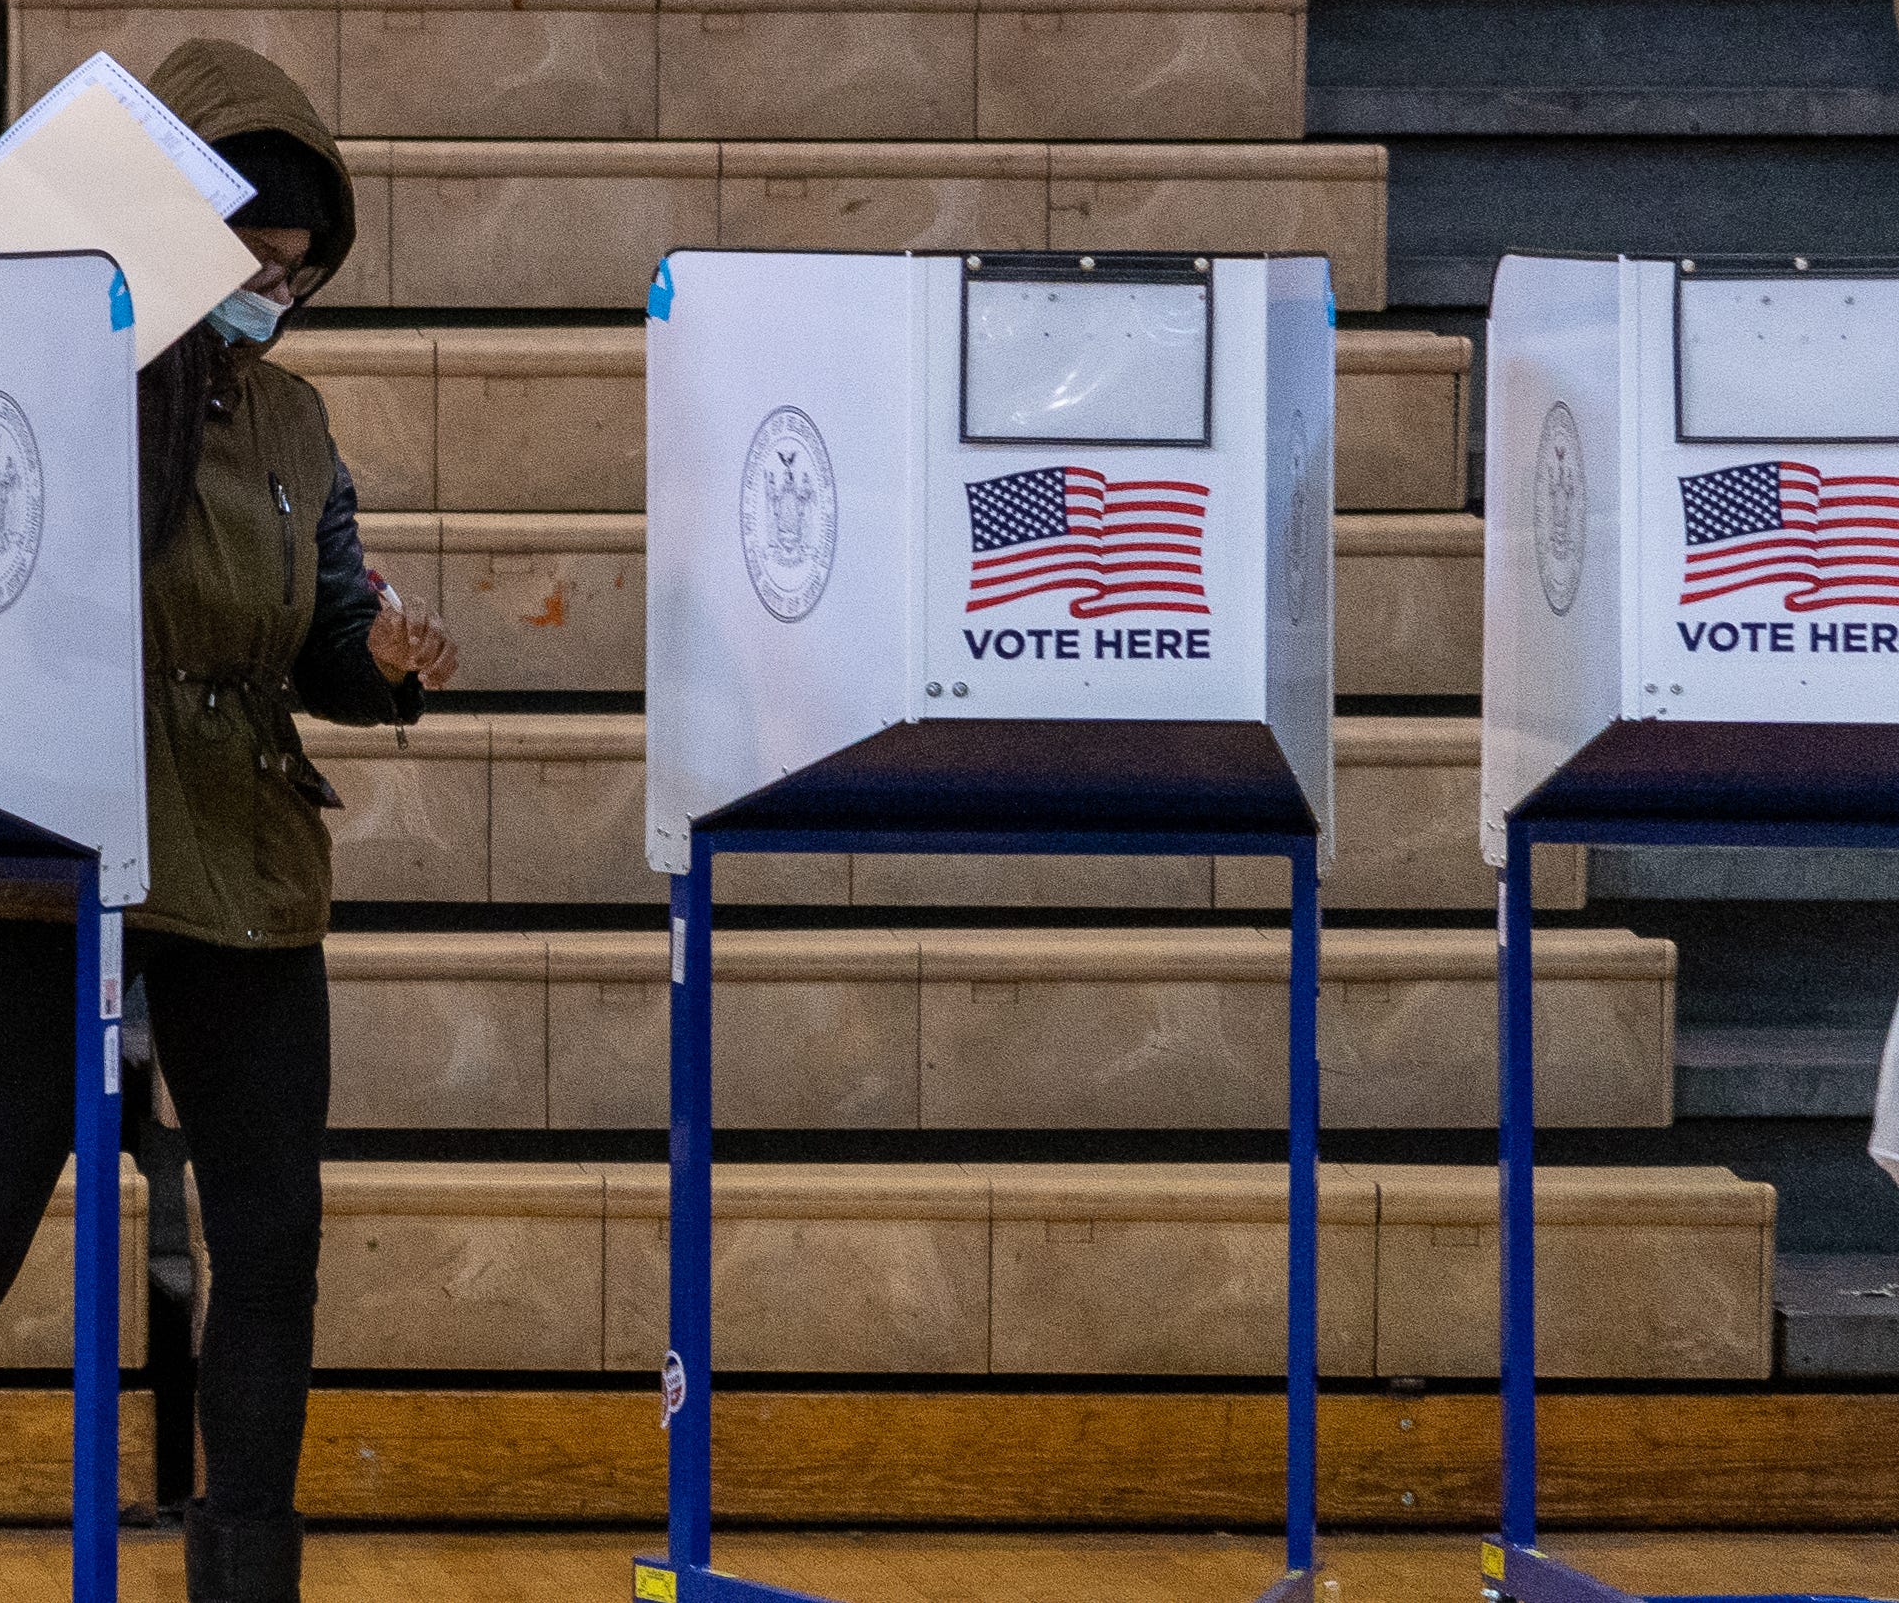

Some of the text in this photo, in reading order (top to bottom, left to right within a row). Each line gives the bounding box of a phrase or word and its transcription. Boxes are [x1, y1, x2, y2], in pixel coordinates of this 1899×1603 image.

[963, 628, 1212, 660] VOTE HERE
[1676, 621, 1796, 653] VOTE
